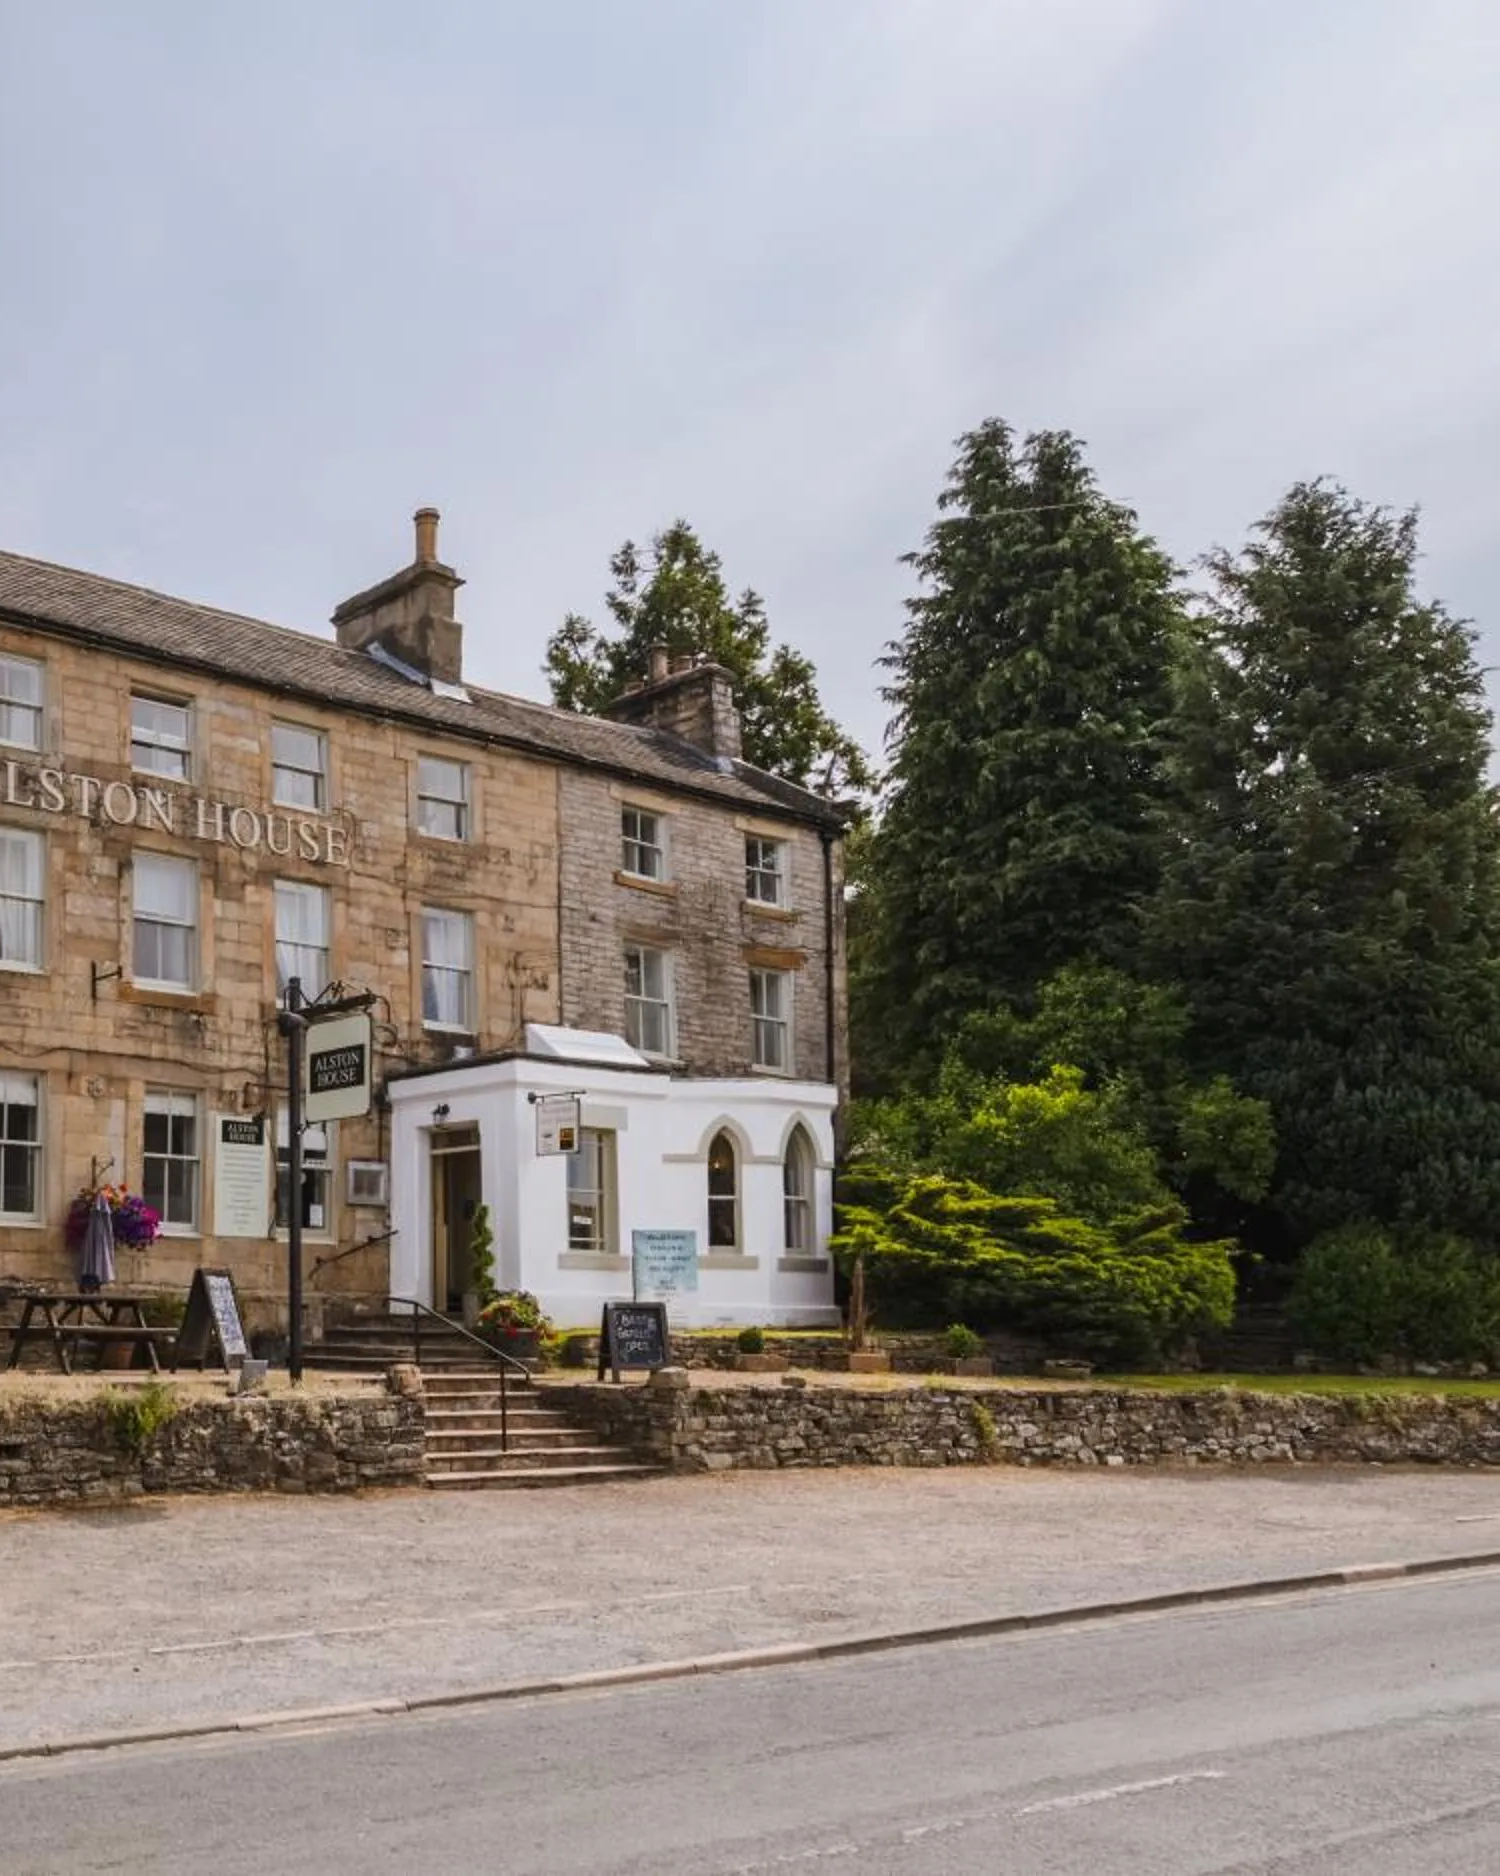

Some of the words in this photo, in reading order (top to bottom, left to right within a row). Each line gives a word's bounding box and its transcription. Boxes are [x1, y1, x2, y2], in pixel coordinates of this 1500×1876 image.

[195, 798, 350, 866] HOUSE
[315, 1050, 360, 1072] ALSTON
[317, 1067, 357, 1087] HOUSE
